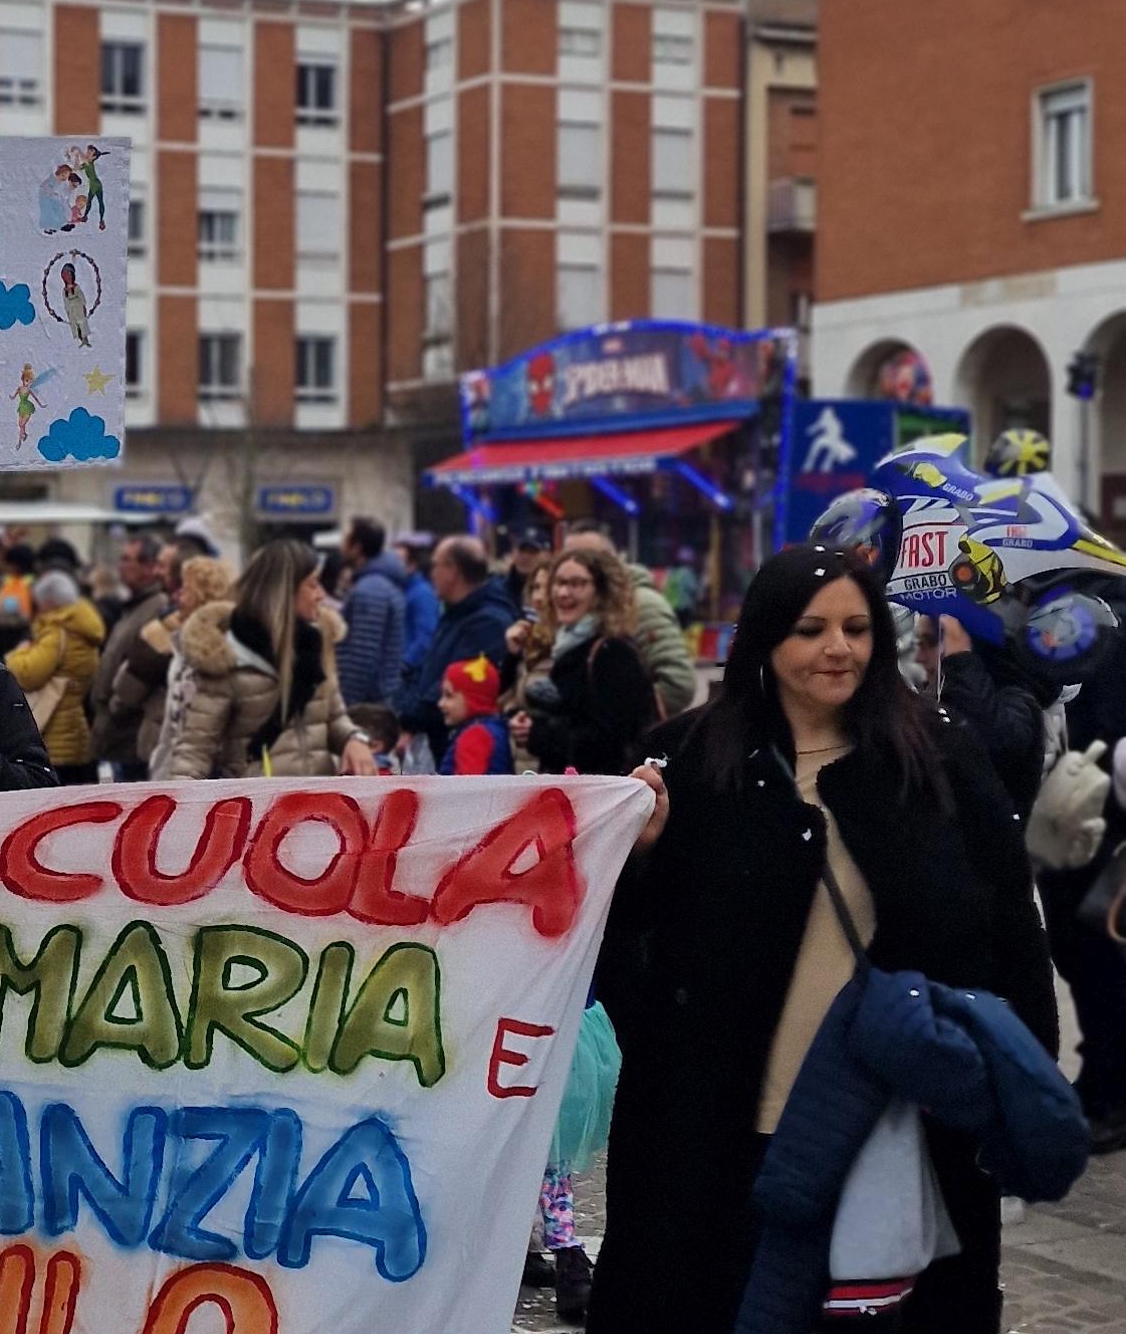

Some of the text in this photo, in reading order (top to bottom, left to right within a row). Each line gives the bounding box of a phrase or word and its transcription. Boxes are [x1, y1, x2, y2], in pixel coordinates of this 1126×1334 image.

[942, 482, 974, 502] GRABO
[901, 531, 949, 568] FAST
[1002, 538, 1033, 548] GRABO
[904, 573, 947, 590] GRABO
[899, 586, 957, 601] MOTOR
[487, 1017, 556, 1099] E
